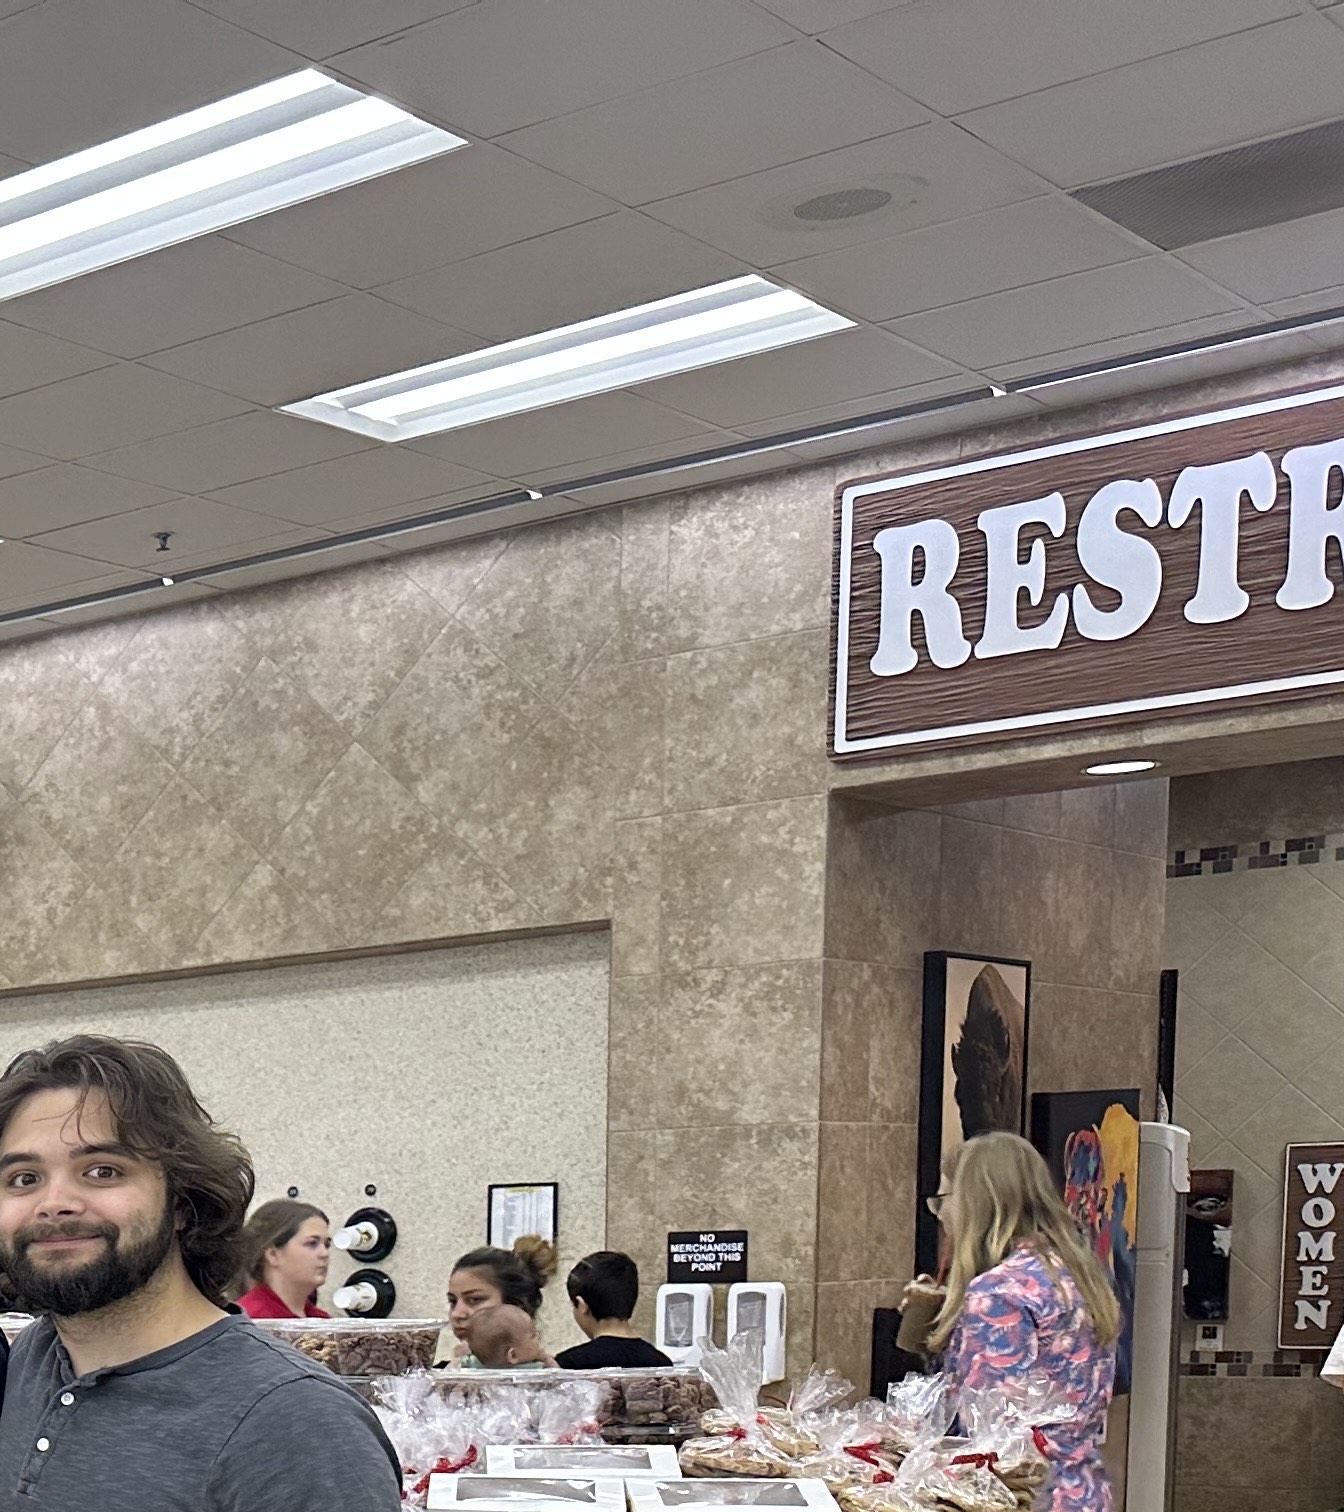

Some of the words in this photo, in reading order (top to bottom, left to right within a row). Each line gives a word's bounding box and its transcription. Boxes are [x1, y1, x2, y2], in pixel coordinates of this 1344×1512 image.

[699, 1233, 715, 1243] NO
[670, 1242, 745, 1253] MERCHANDISE
[1294, 1162, 1344, 1330] WOMEN
[673, 1252, 716, 1263] BEYOND
[718, 1252, 742, 1262] THIS
[691, 1262, 723, 1272] POINT
